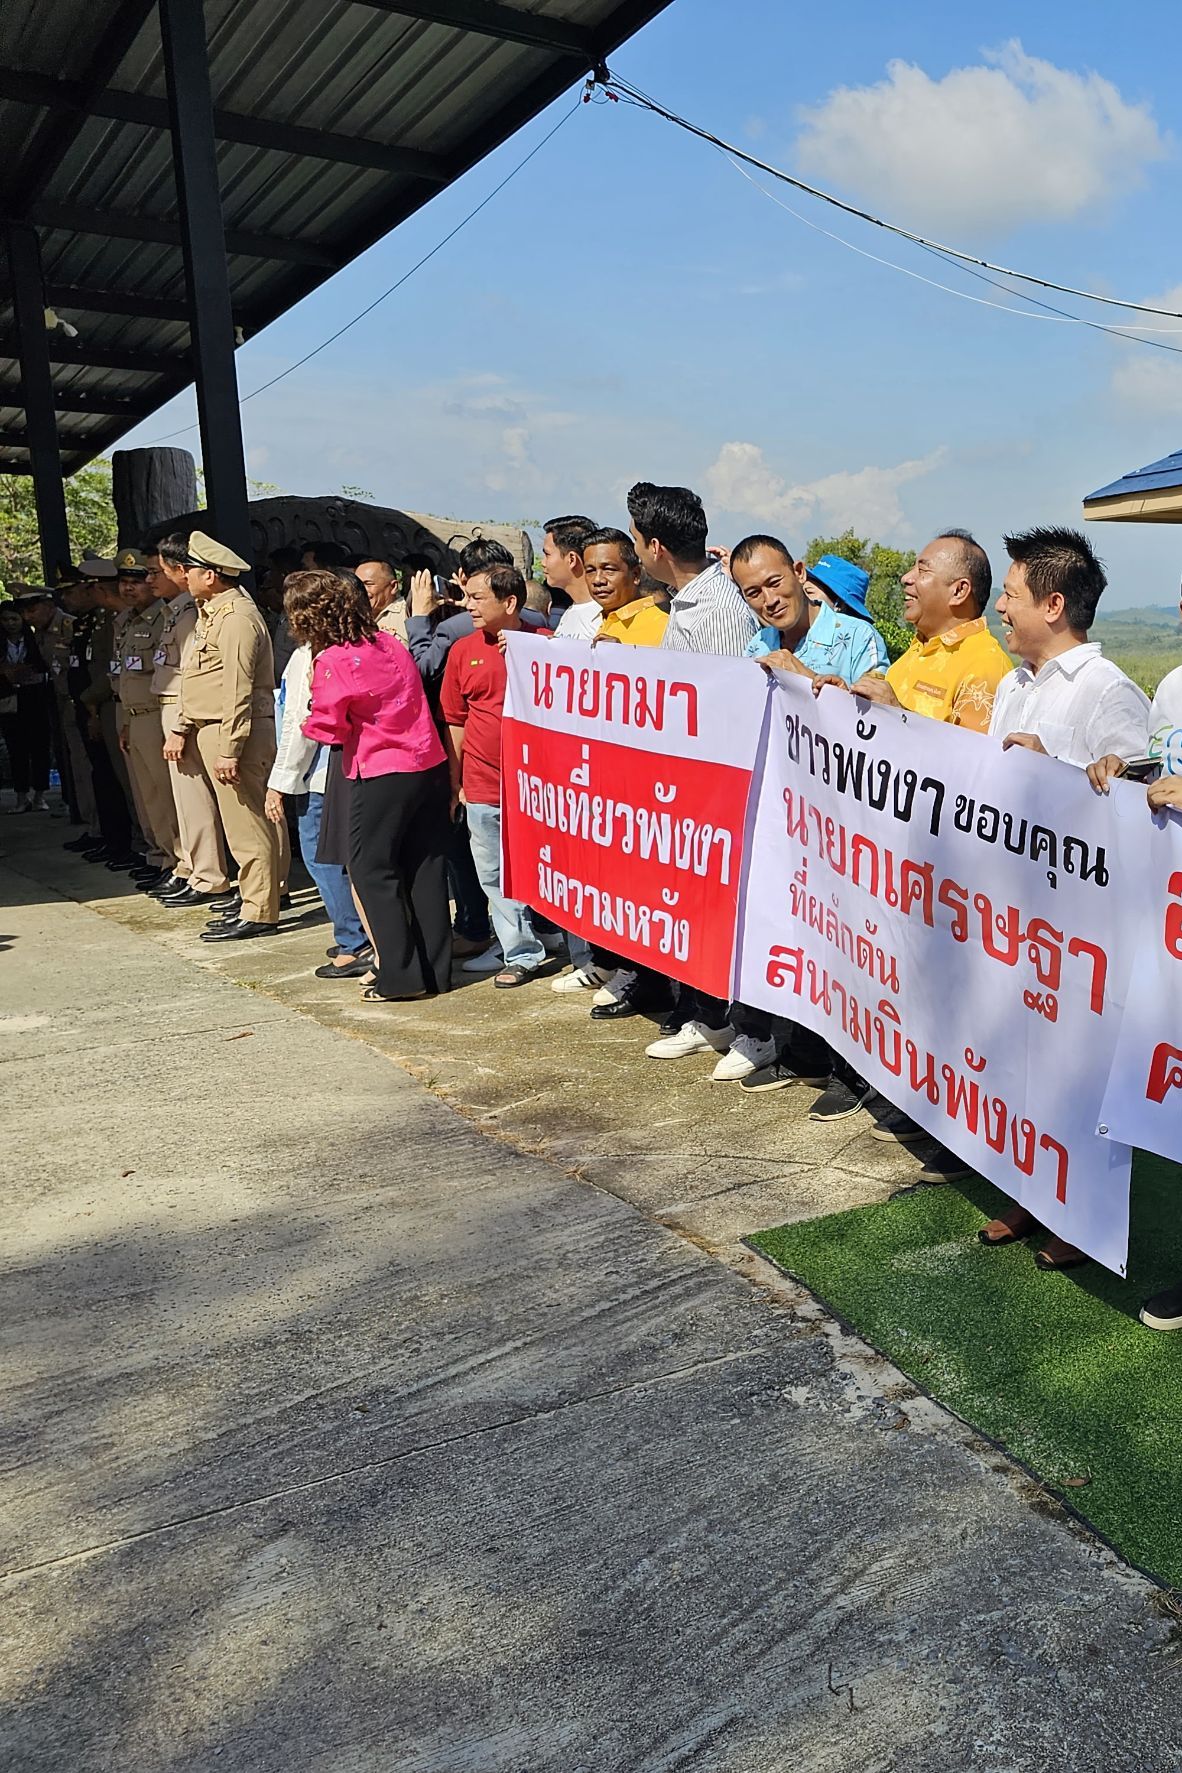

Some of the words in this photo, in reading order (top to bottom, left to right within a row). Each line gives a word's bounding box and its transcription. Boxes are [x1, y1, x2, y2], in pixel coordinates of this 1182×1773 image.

[531, 660, 699, 737] นายกมา
[517, 743, 733, 886] ท่องเที่ยวพังงา
[785, 713, 946, 837] ชาวพังงา
[954, 793, 1110, 890] ขอบคุณ
[537, 844, 690, 962] มีความหวัง
[783, 786, 1109, 1023] นายกเศรษฐา
[789, 856, 900, 994] ที่ผลักดัน
[766, 944, 1069, 1204] สนามบินพังงา
